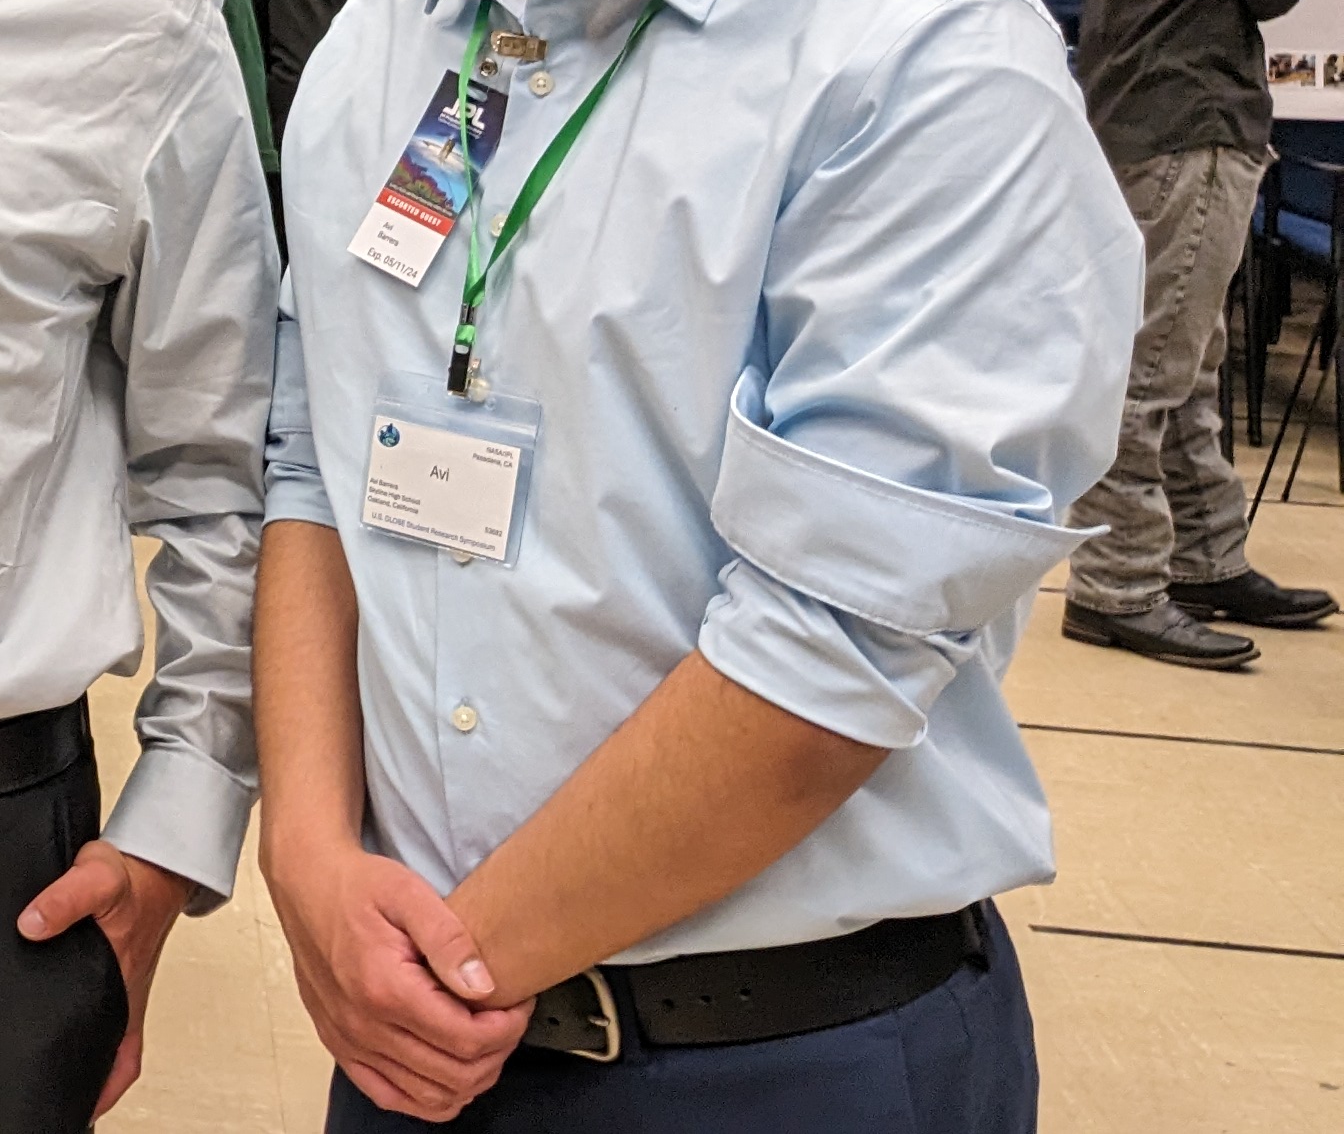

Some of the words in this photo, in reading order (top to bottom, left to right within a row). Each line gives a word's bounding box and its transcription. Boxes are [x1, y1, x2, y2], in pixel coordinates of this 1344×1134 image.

[387, 195, 419, 216] ESCORTED
[420, 210, 442, 227] GUEST
[382, 221, 393, 230] Avi
[377, 230, 399, 246] Barrera
[367, 247, 381, 260] Exp.
[383, 255, 417, 278] 05/11/24
[429, 465, 449, 481] Avi
